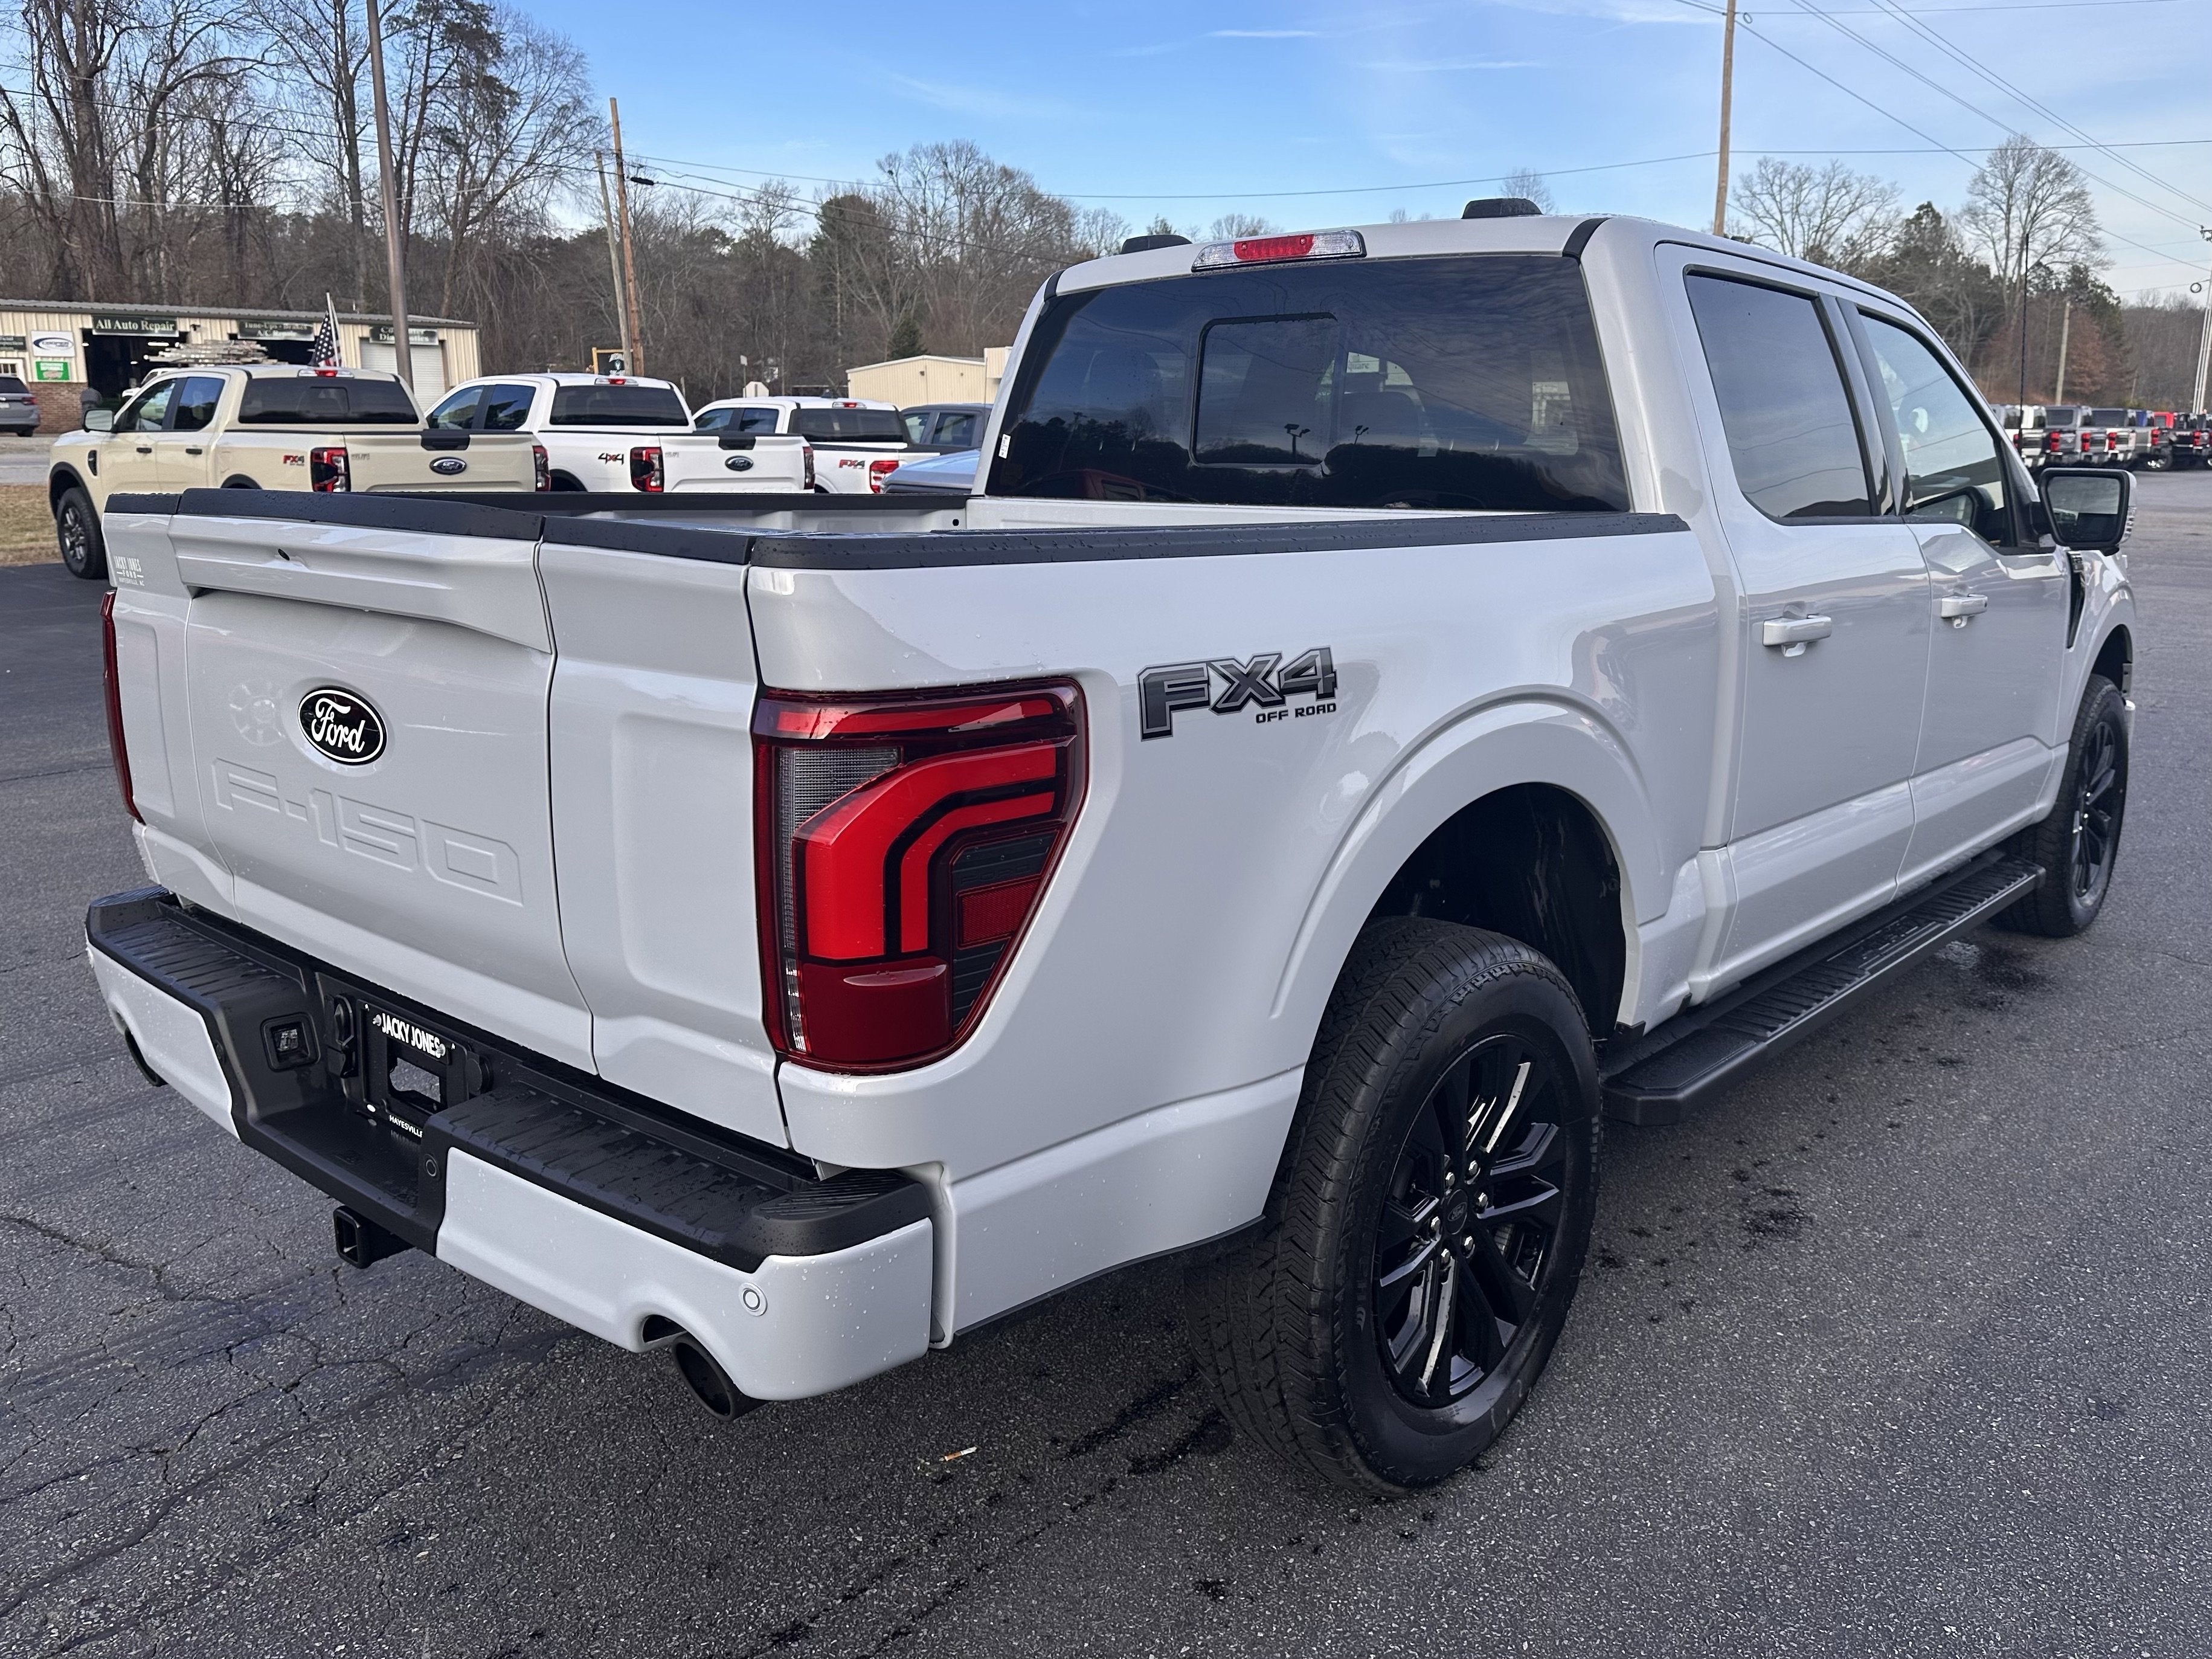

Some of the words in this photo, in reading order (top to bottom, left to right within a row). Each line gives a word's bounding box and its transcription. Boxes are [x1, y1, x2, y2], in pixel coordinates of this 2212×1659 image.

[95, 319, 111, 330] All
[114, 320, 139, 330] Auto
[141, 320, 175, 333] Repair
[283, 454, 305, 465] FX4
[838, 459, 866, 468] FX4
[113, 555, 128, 570] JACKY
[126, 557, 142, 573] JONES
[123, 569, 137, 579] FORD
[1136, 645, 1338, 743] FX4
[1255, 709, 1290, 724] OFF
[1294, 702, 1337, 718] ROAD
[310, 697, 366, 753] Ford
[211, 758, 524, 907] F-150
[382, 1013, 410, 1044] JACKY
[410, 1025, 442, 1058] JONES
